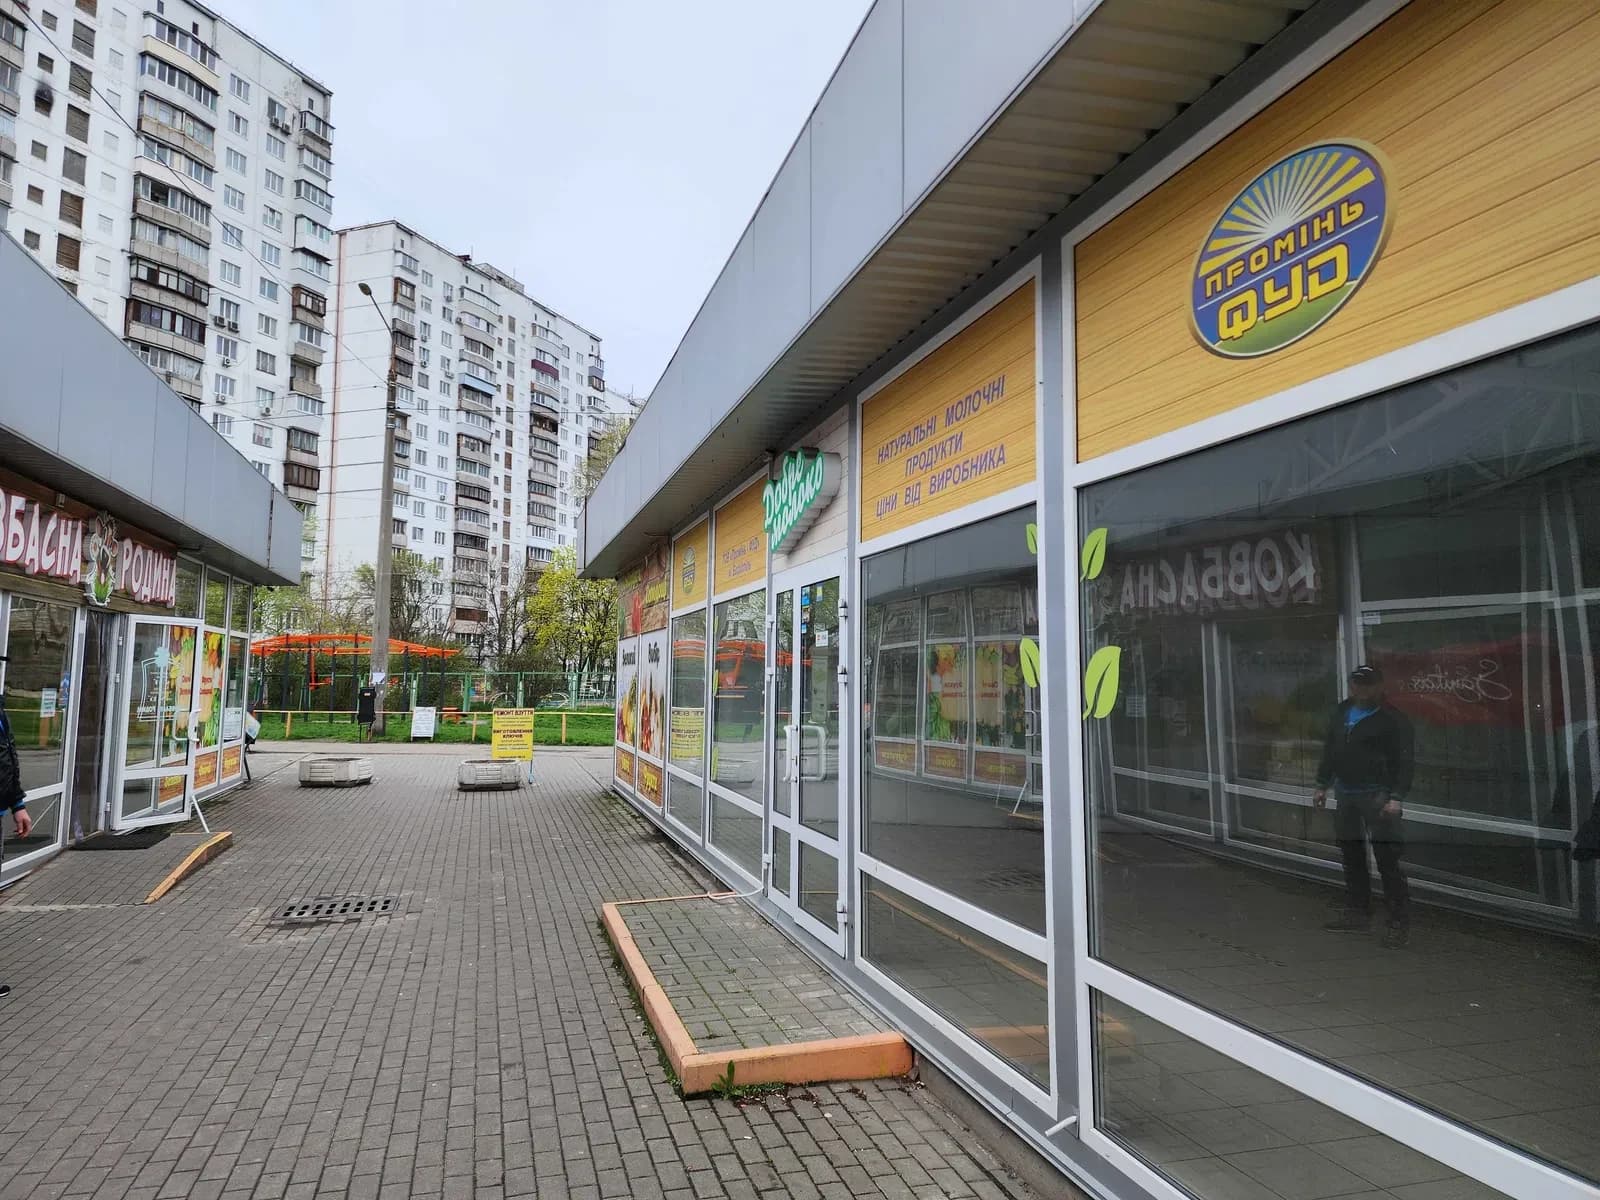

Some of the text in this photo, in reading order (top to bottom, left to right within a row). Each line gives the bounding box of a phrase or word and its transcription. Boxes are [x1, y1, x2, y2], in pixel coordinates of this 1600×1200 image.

[1204, 198, 1365, 298] ПРОМІНЬ
[877, 374, 1006, 465] НАТУРАЛЬНІ МОЛОЧНІ
[905, 432, 964, 477] ПРОДУКТИ
[876, 444, 1006, 521] ЦІНИ ВІД ВИРОБНИКА
[121, 538, 177, 607] РОДИНА
